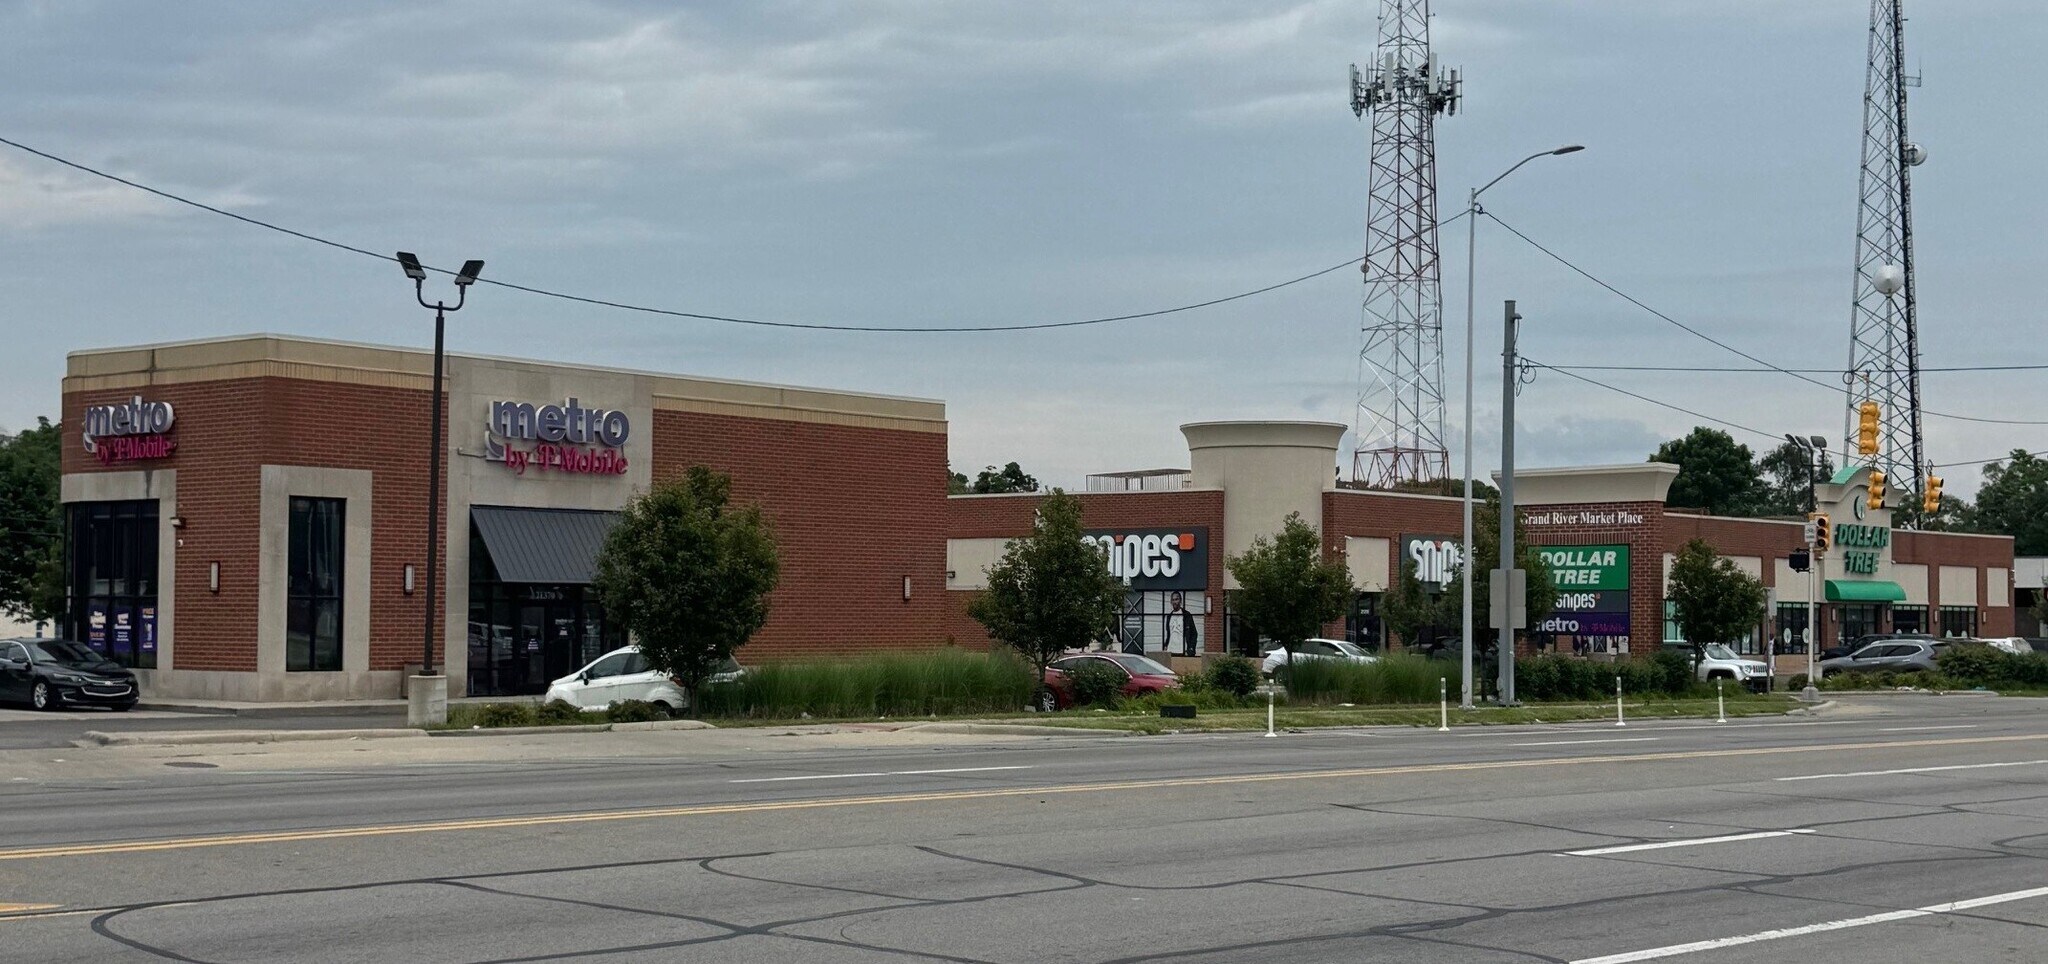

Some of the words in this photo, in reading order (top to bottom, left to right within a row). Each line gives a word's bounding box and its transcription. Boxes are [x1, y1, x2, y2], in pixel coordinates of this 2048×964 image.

[86, 396, 173, 435] metro
[490, 397, 630, 447] metro
[97, 441, 110, 467] by
[505, 443, 529, 475] by
[1552, 512, 1578, 524] River
[1580, 511, 1615, 524] Market
[1617, 511, 1643, 524] Place
[1835, 524, 1890, 547] DOLLAR
[1844, 551, 1879, 574] TREE
[1553, 569, 1601, 585] TREE
